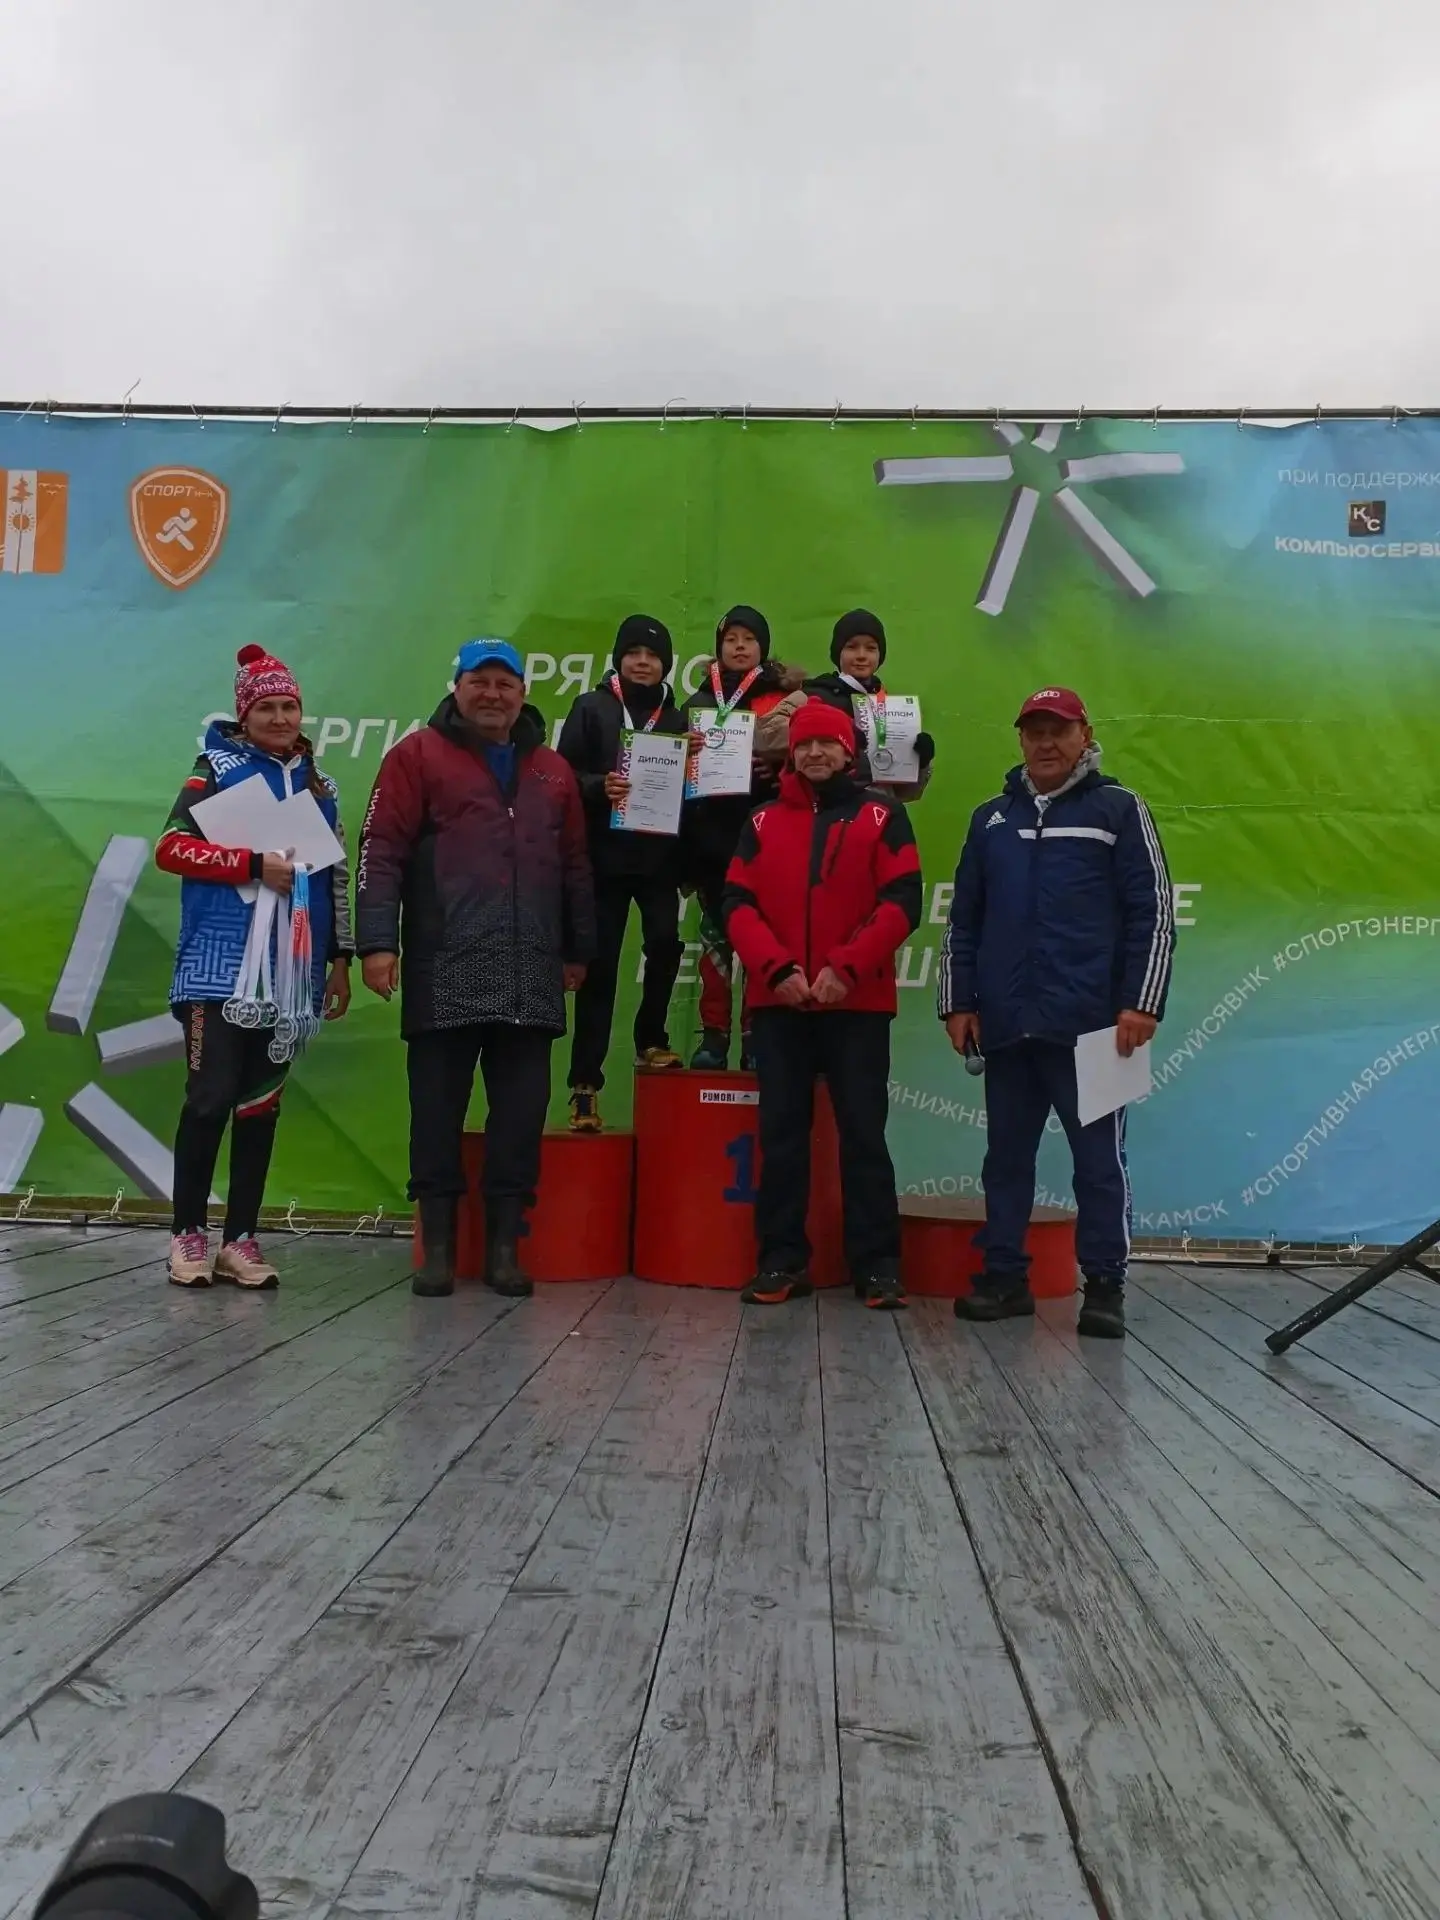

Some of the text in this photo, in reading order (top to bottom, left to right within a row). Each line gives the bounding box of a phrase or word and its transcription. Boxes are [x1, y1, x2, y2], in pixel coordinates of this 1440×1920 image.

[1278, 469, 1318, 485] при
[143, 484, 194, 497] СПОРТ
[637, 755, 678, 767] ДИПЛОМ
[169, 841, 241, 868] KAZAN
[702, 1092, 736, 1102] PUMORI
[723, 1134, 758, 1203] 1
